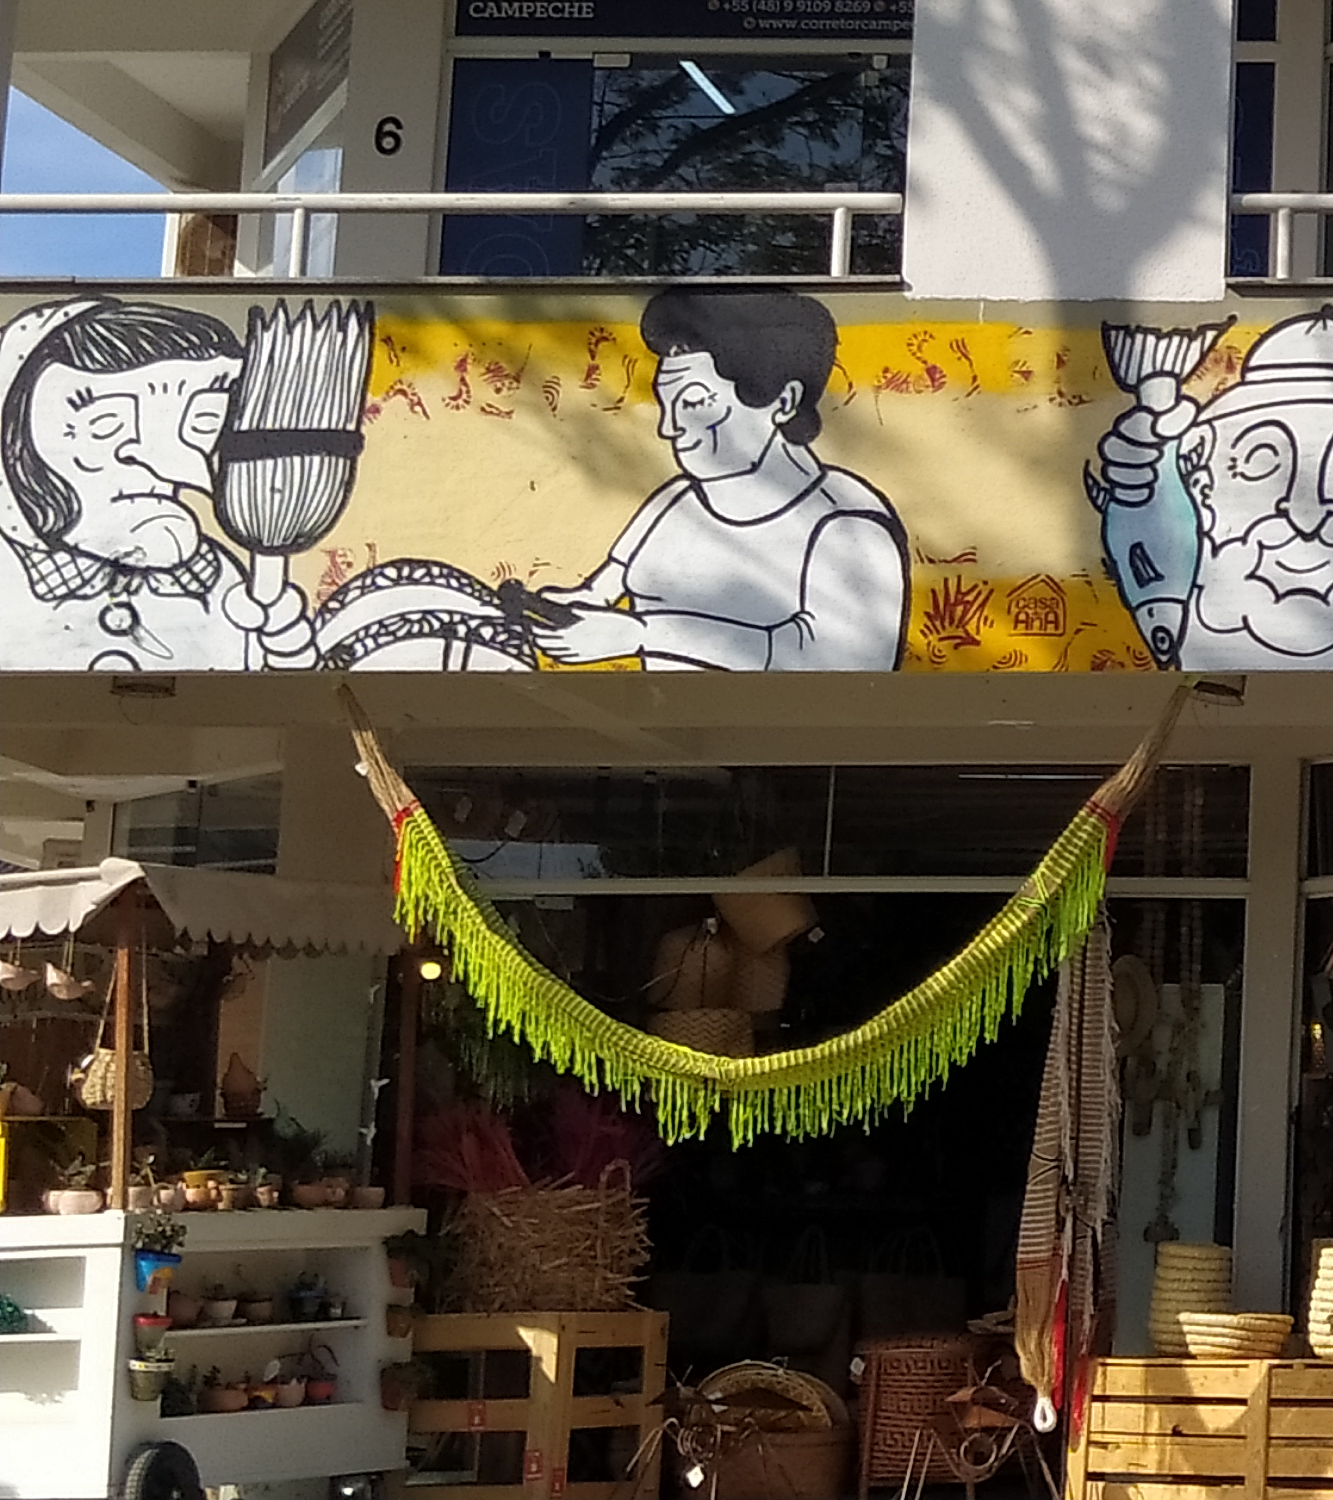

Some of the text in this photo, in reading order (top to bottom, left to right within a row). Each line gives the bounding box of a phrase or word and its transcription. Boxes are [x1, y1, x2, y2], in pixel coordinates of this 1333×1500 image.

[469, 2, 595, 18] CAMPECHE
[374, 116, 404, 155] 6
[1014, 596, 1060, 610] casa
